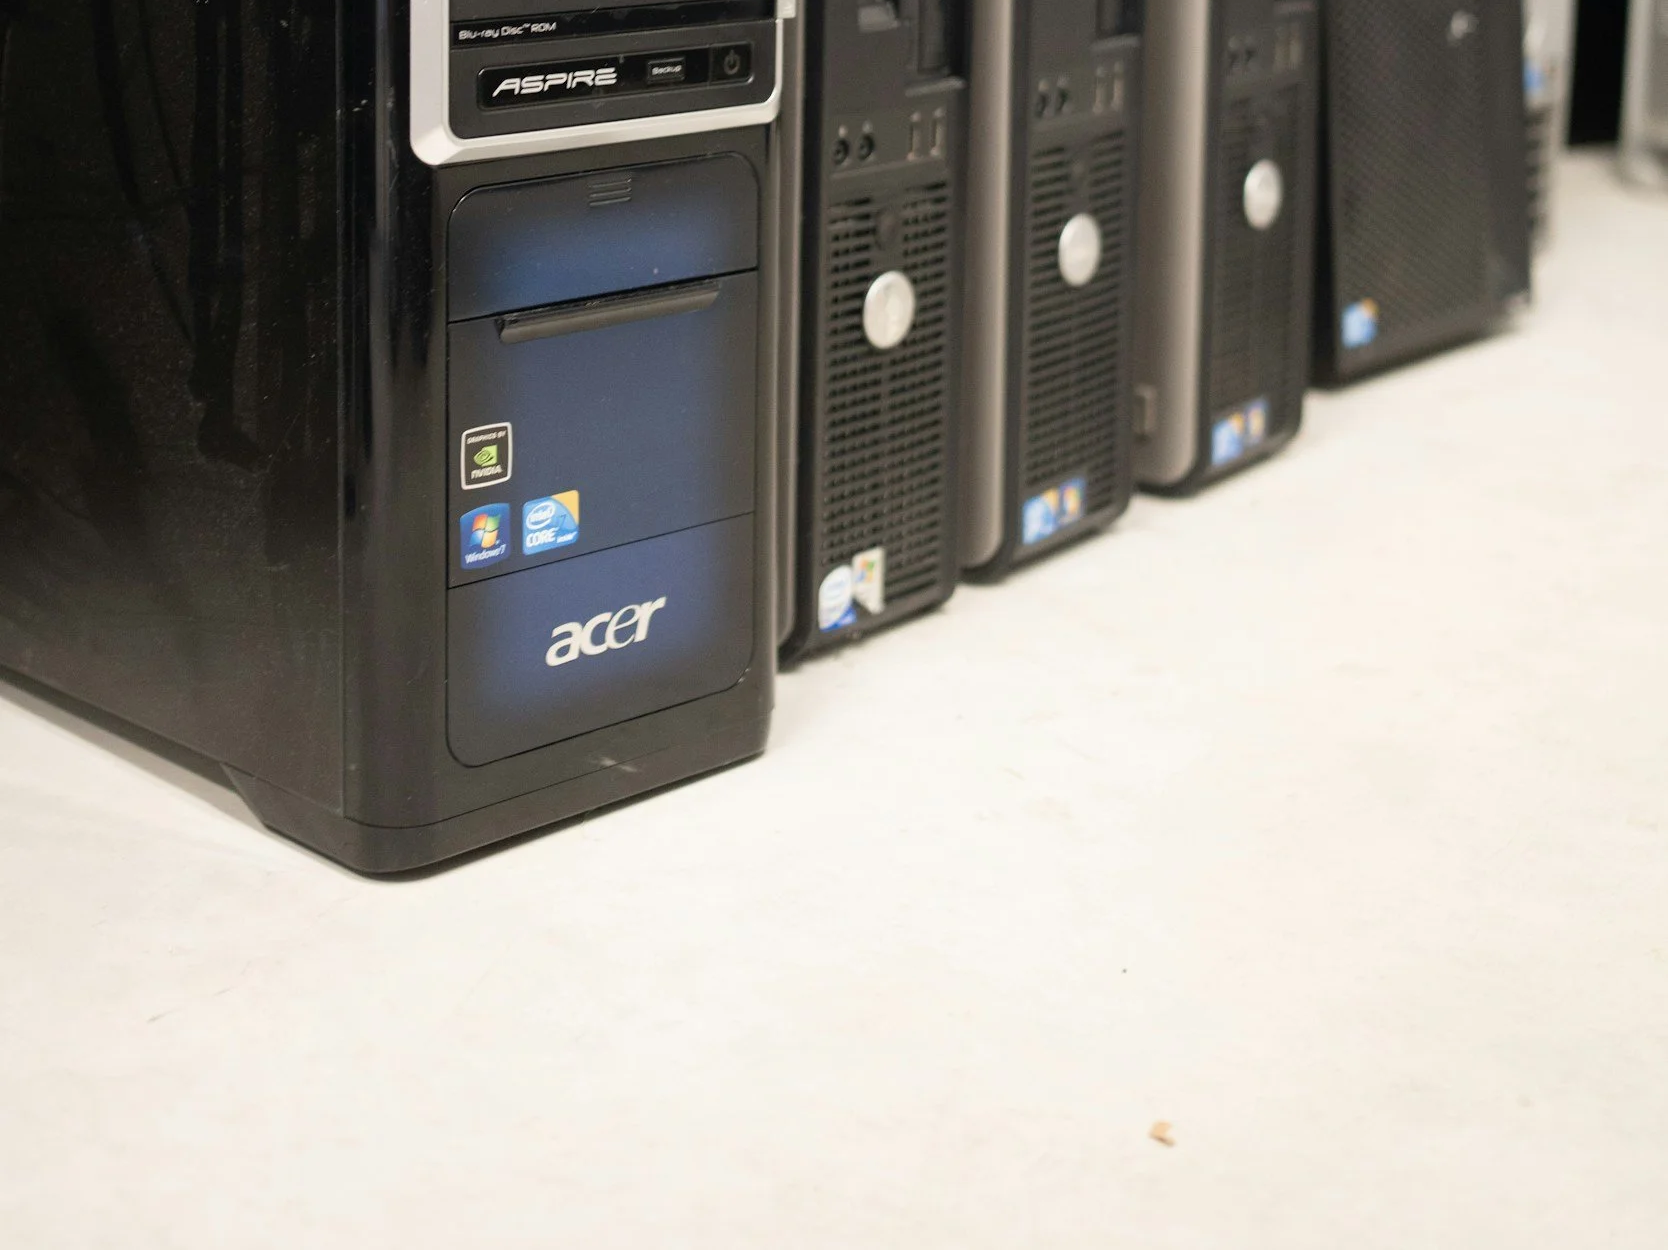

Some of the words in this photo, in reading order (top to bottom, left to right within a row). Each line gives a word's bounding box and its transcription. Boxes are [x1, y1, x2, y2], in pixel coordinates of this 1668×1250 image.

[458, 29, 500, 40] Blu-ray
[530, 22, 557, 33] ROM
[492, 67, 617, 97] ASPIRE
[545, 596, 667, 666] acer
